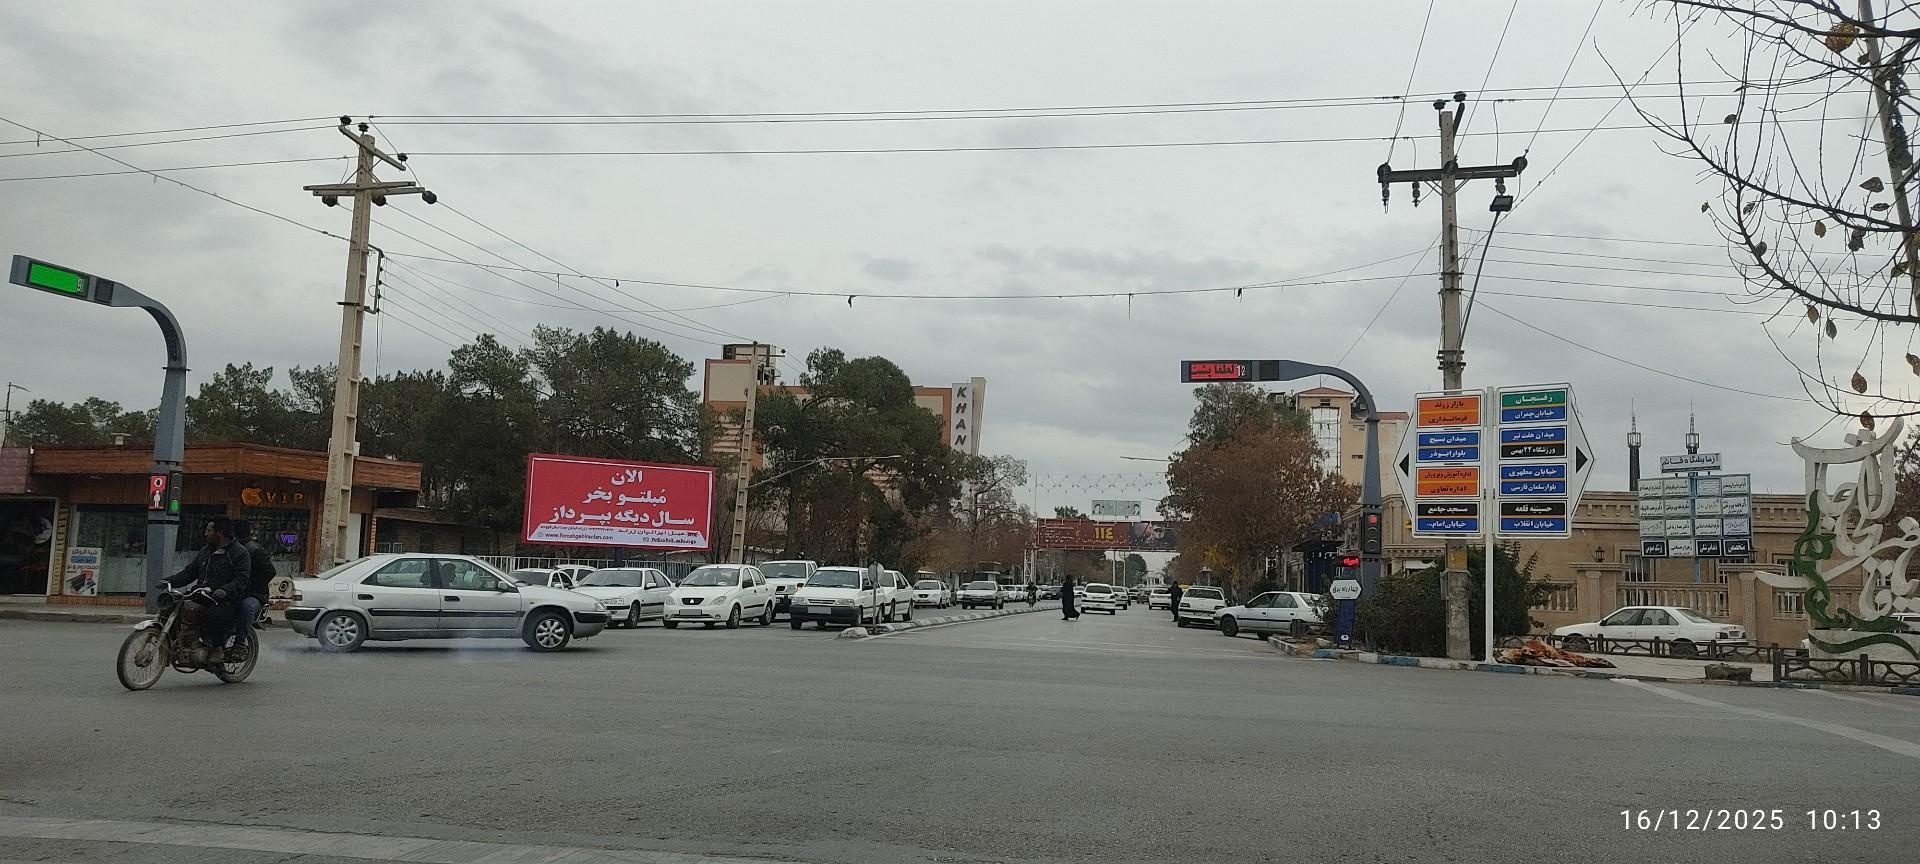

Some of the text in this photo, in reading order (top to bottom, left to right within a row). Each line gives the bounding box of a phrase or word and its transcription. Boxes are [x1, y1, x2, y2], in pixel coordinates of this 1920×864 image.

[1515, 393, 1552, 404] رفسنجان
[1435, 400, 1464, 409] بازار زرند
[954, 386, 967, 446] KHAN
[1515, 409, 1554, 419] خیابان چمران
[1429, 415, 1468, 424] فرمانداری
[1429, 436, 1466, 444] میدان بسیج
[1512, 432, 1521, 440] تیر
[1536, 431, 1555, 440] میدان
[1430, 449, 1466, 458] بلوار ابوذر
[1511, 448, 1524, 456] بهمن
[1532, 446, 1556, 455] ورزشگاه
[1661, 455, 1719, 466] آزمایشگاه قائم
[1444, 470, 1460, 479] آموزش
[1508, 467, 1557, 477] خیابان مطهری
[610, 469, 643, 486] الان
[1430, 485, 1467, 494] اداره تعاون
[1510, 482, 1557, 492] بلوار سلمان فارسی
[266, 491, 305, 505] VIP
[582, 486, 613, 504] بخر
[1427, 506, 1468, 514] مسجد جامع
[1515, 504, 1552, 514] حسینیه قلعه
[549, 504, 695, 528] سال دیگه بپرداز
[1445, 520, 1467, 529] خیابان
[1513, 520, 1555, 529] خیابان انقلاب
